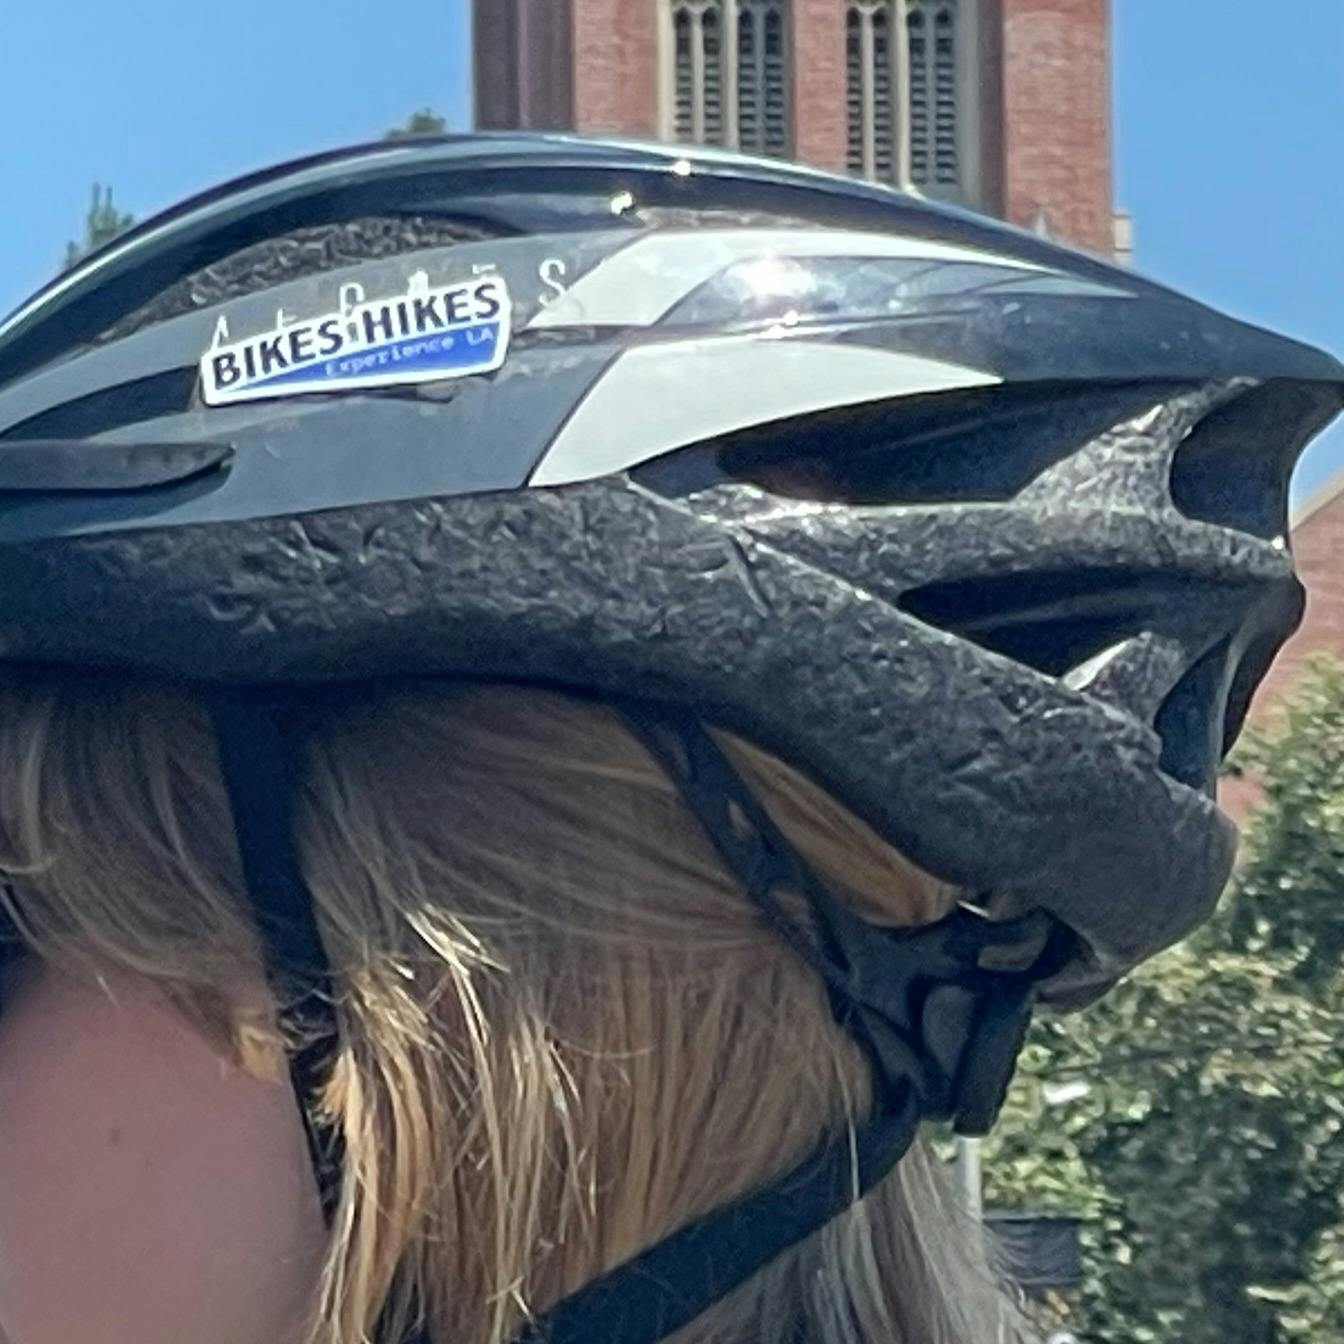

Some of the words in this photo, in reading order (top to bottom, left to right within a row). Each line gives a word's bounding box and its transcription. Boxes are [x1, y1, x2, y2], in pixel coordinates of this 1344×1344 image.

[211, 319, 344, 391] BIKES
[362, 283, 501, 345] HIKES
[324, 336, 455, 377] Experience
[465, 327, 495, 346] LA
